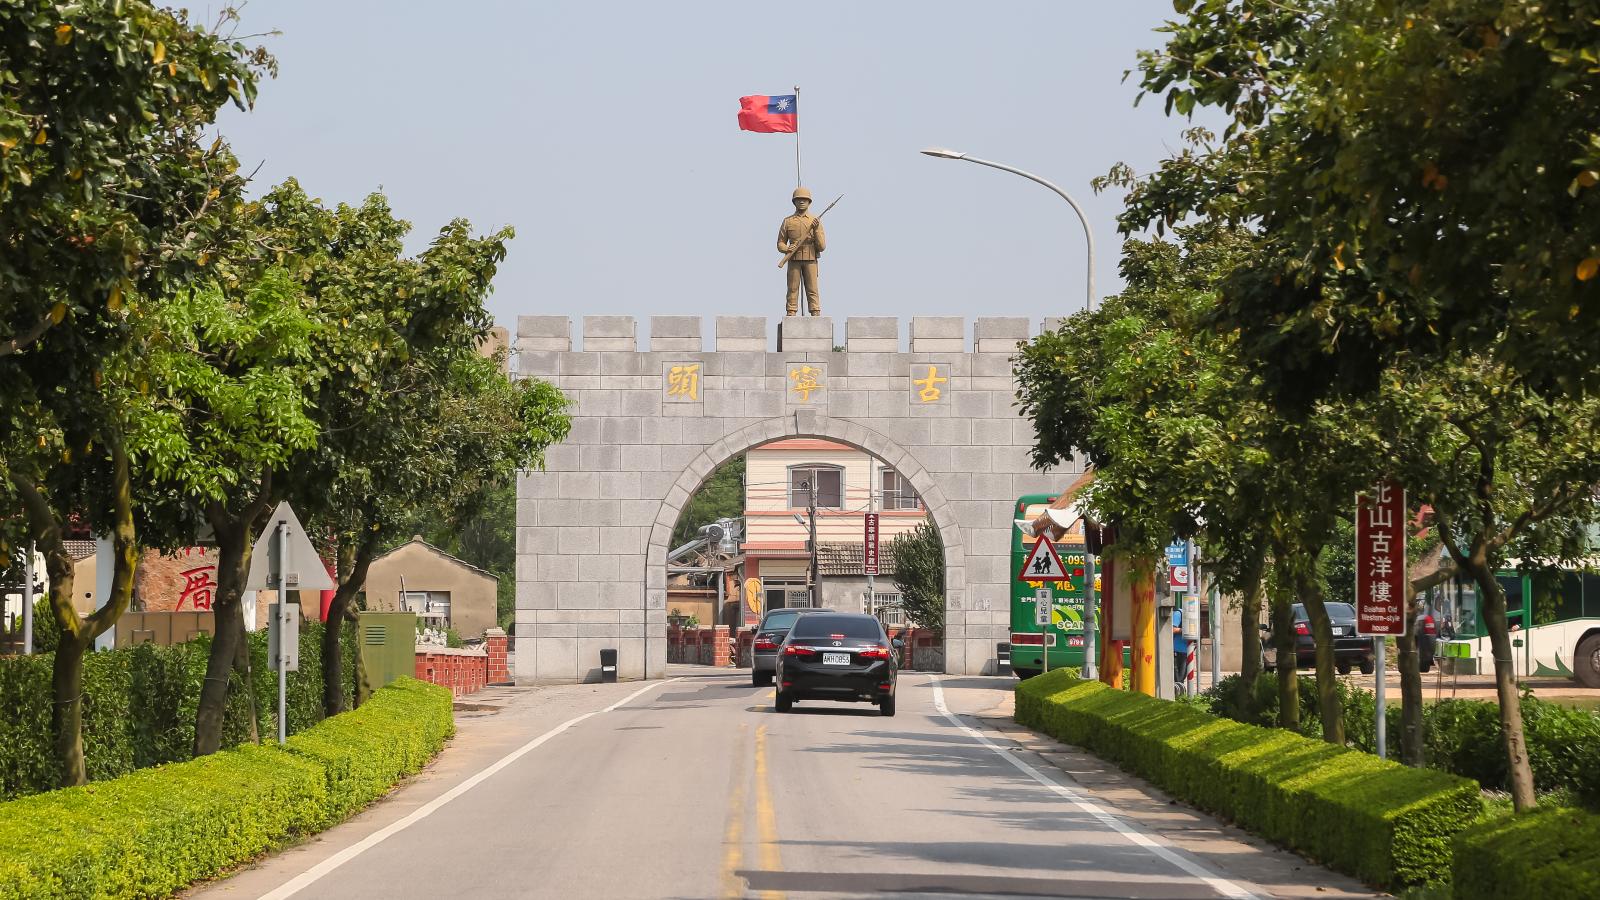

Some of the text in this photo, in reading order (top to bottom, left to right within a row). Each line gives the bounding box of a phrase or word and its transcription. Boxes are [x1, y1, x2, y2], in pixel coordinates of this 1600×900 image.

[1388, 605, 1398, 613] Old
[1361, 614, 1400, 623] Western-style
[1371, 624, 1389, 632] house
